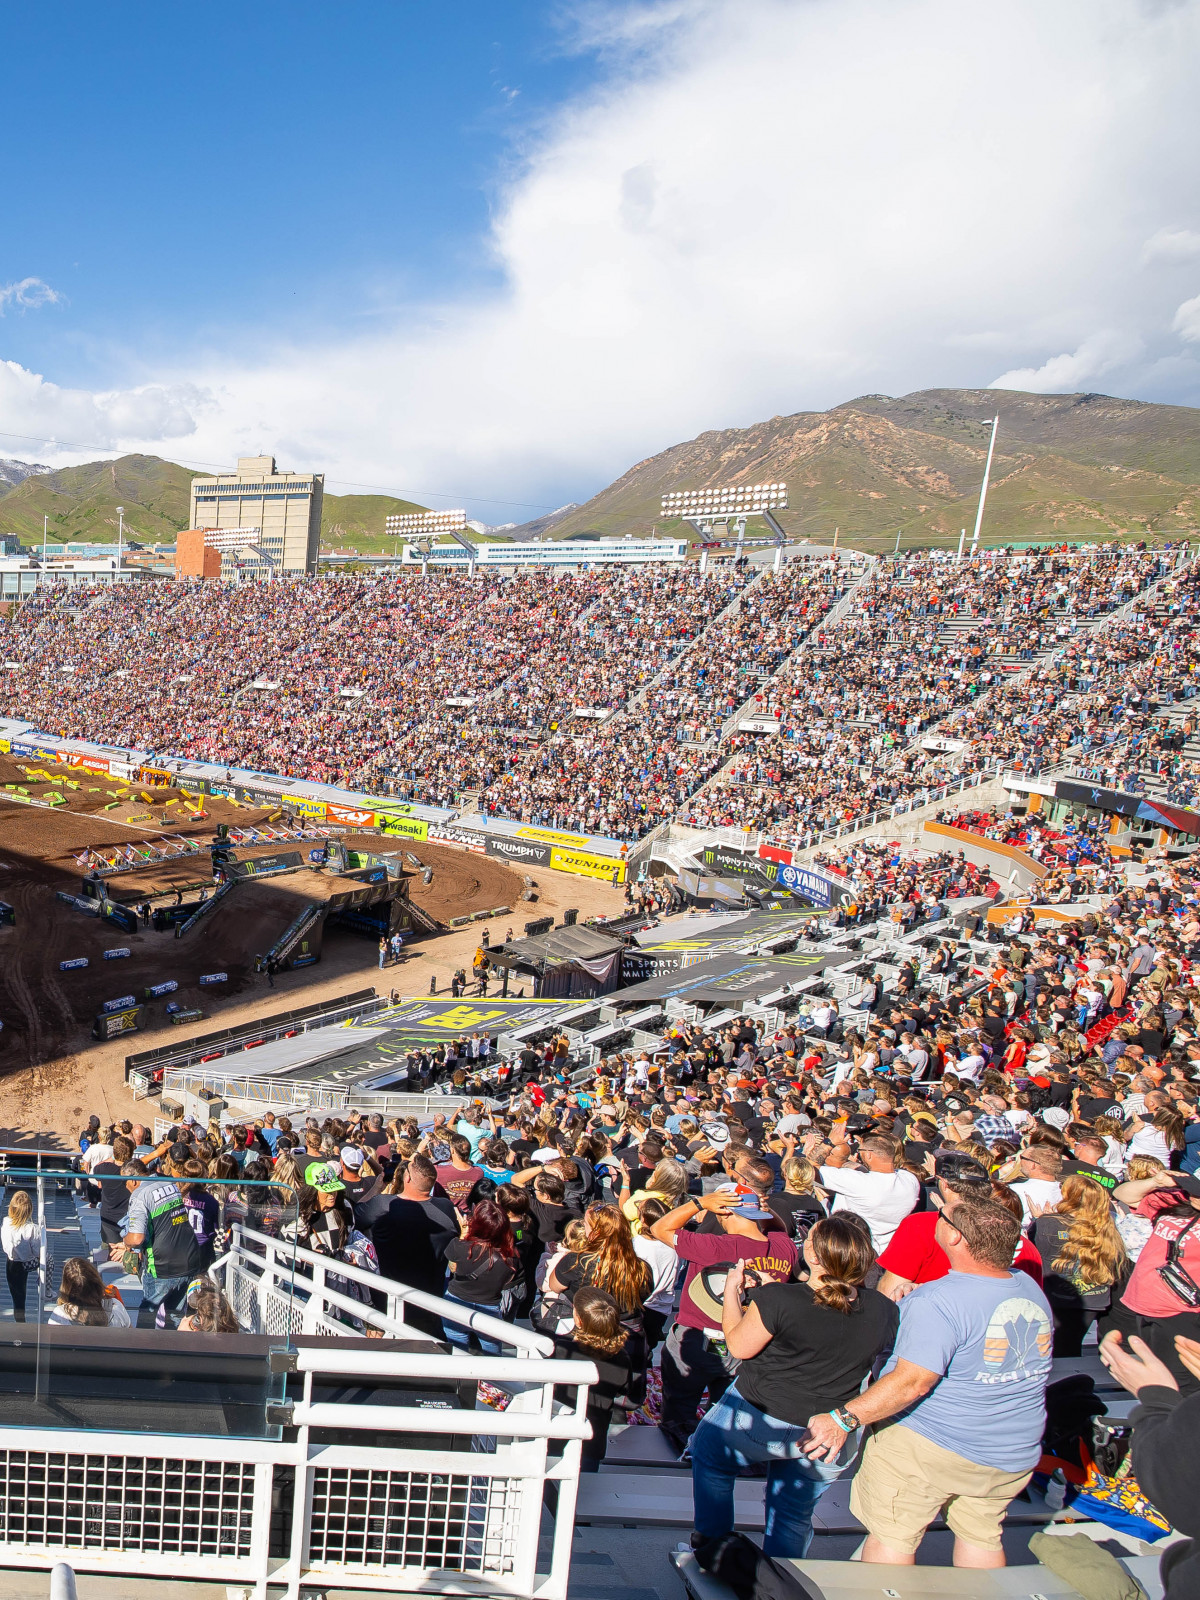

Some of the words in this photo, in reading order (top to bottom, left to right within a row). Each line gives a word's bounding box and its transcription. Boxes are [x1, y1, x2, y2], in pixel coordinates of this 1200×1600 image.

[936, 742, 947, 750] 41
[82, 759, 109, 771] GASGAS
[210, 783, 236, 793] GoPro
[328, 805, 372, 823] FLY
[384, 821, 423, 836] awasaki
[531, 832, 584, 844] DUNLOP
[491, 841, 534, 857] TRIUMPH
[564, 857, 622, 872] DUNLOP
[717, 854, 761, 871] MONSTER
[796, 870, 829, 897] YAMAHA
[638, 959, 679, 968] SPORTS
[622, 969, 679, 978] MMISSIO
[745, 1256, 792, 1276] STHOUSE
